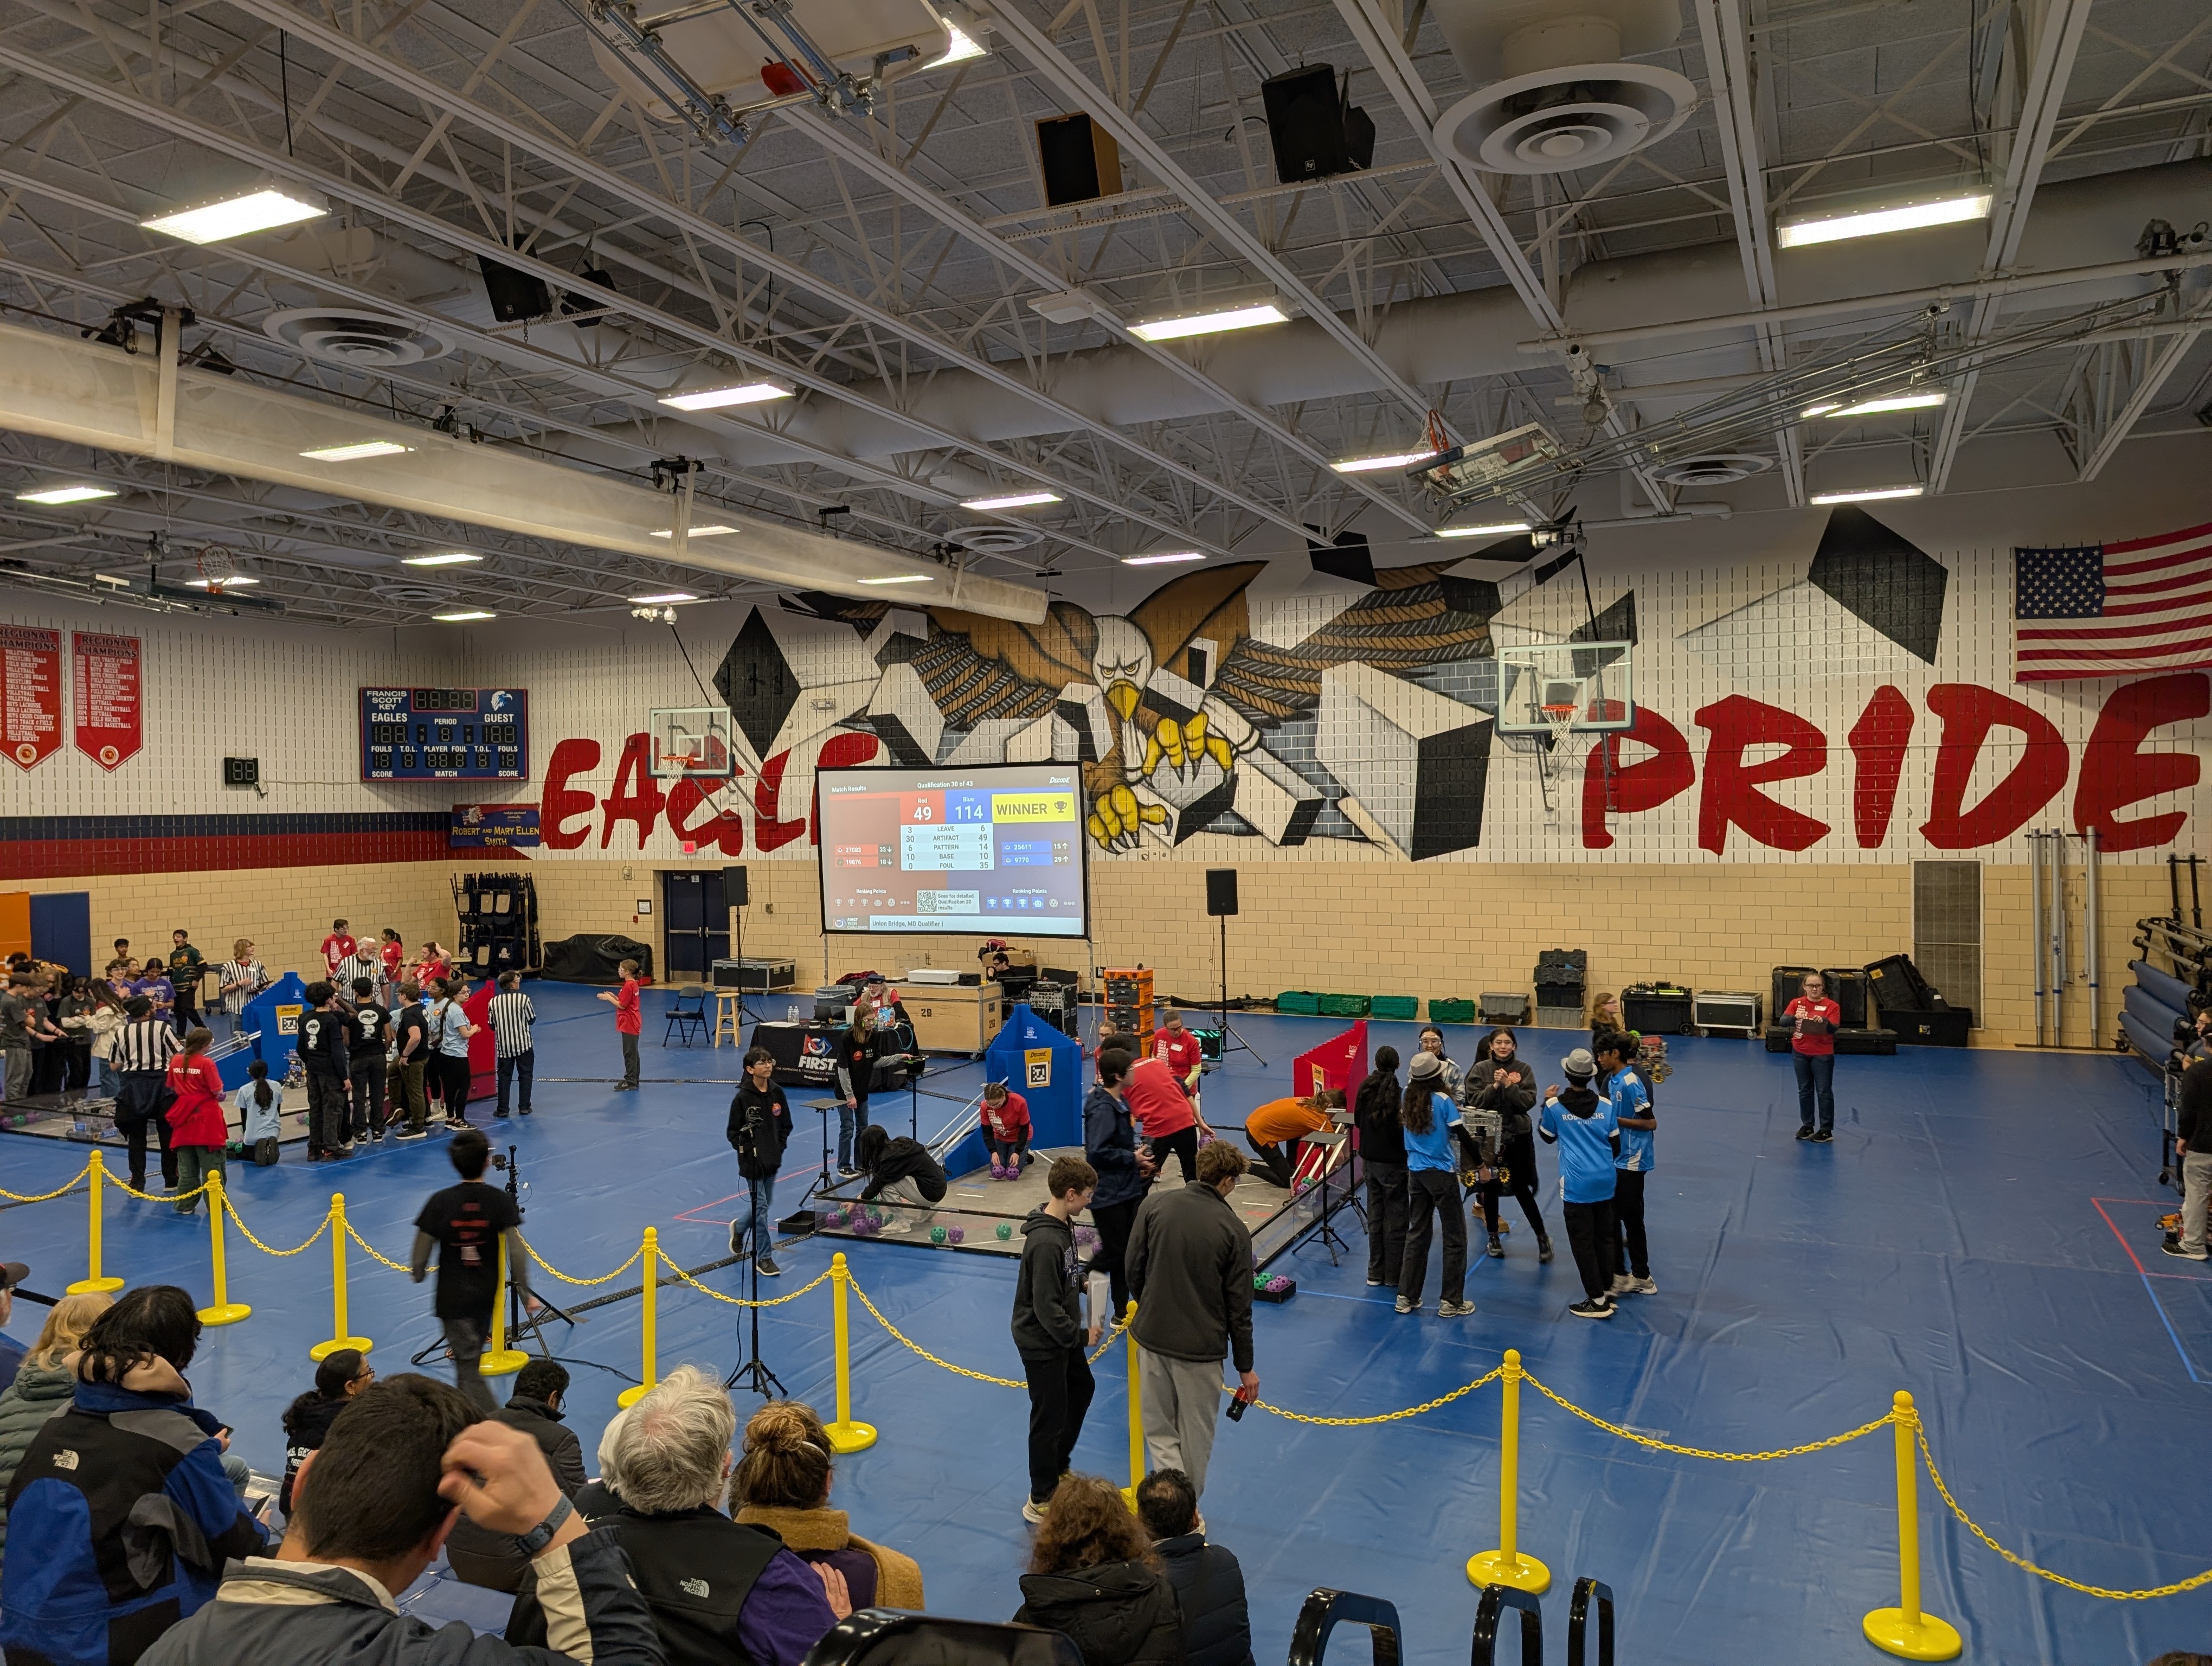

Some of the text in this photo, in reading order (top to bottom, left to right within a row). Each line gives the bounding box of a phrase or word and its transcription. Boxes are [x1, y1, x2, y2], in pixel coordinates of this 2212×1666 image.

[0, 639, 57, 651] HAMPIONS
[82, 636, 131, 648] REGIONAL
[78, 645, 137, 658] CHAMPIONS
[371, 713, 408, 722] EAGLES
[484, 714, 515, 723] GUEST
[1582, 672, 2210, 856] PRIDE
[914, 806, 932, 821] 49
[955, 805, 983, 820] 114
[996, 803, 1047, 816] WINNER
[452, 826, 480, 835] ROBERT
[494, 826, 515, 835] MARY
[516, 825, 539, 835] ELLEN
[485, 837, 507, 845] SMITH
[798, 1055, 838, 1071] FIRST
[54, 1460, 70, 1469] FACE
[679, 1580, 700, 1590] NORTH
[684, 1586, 699, 1595] FACE
